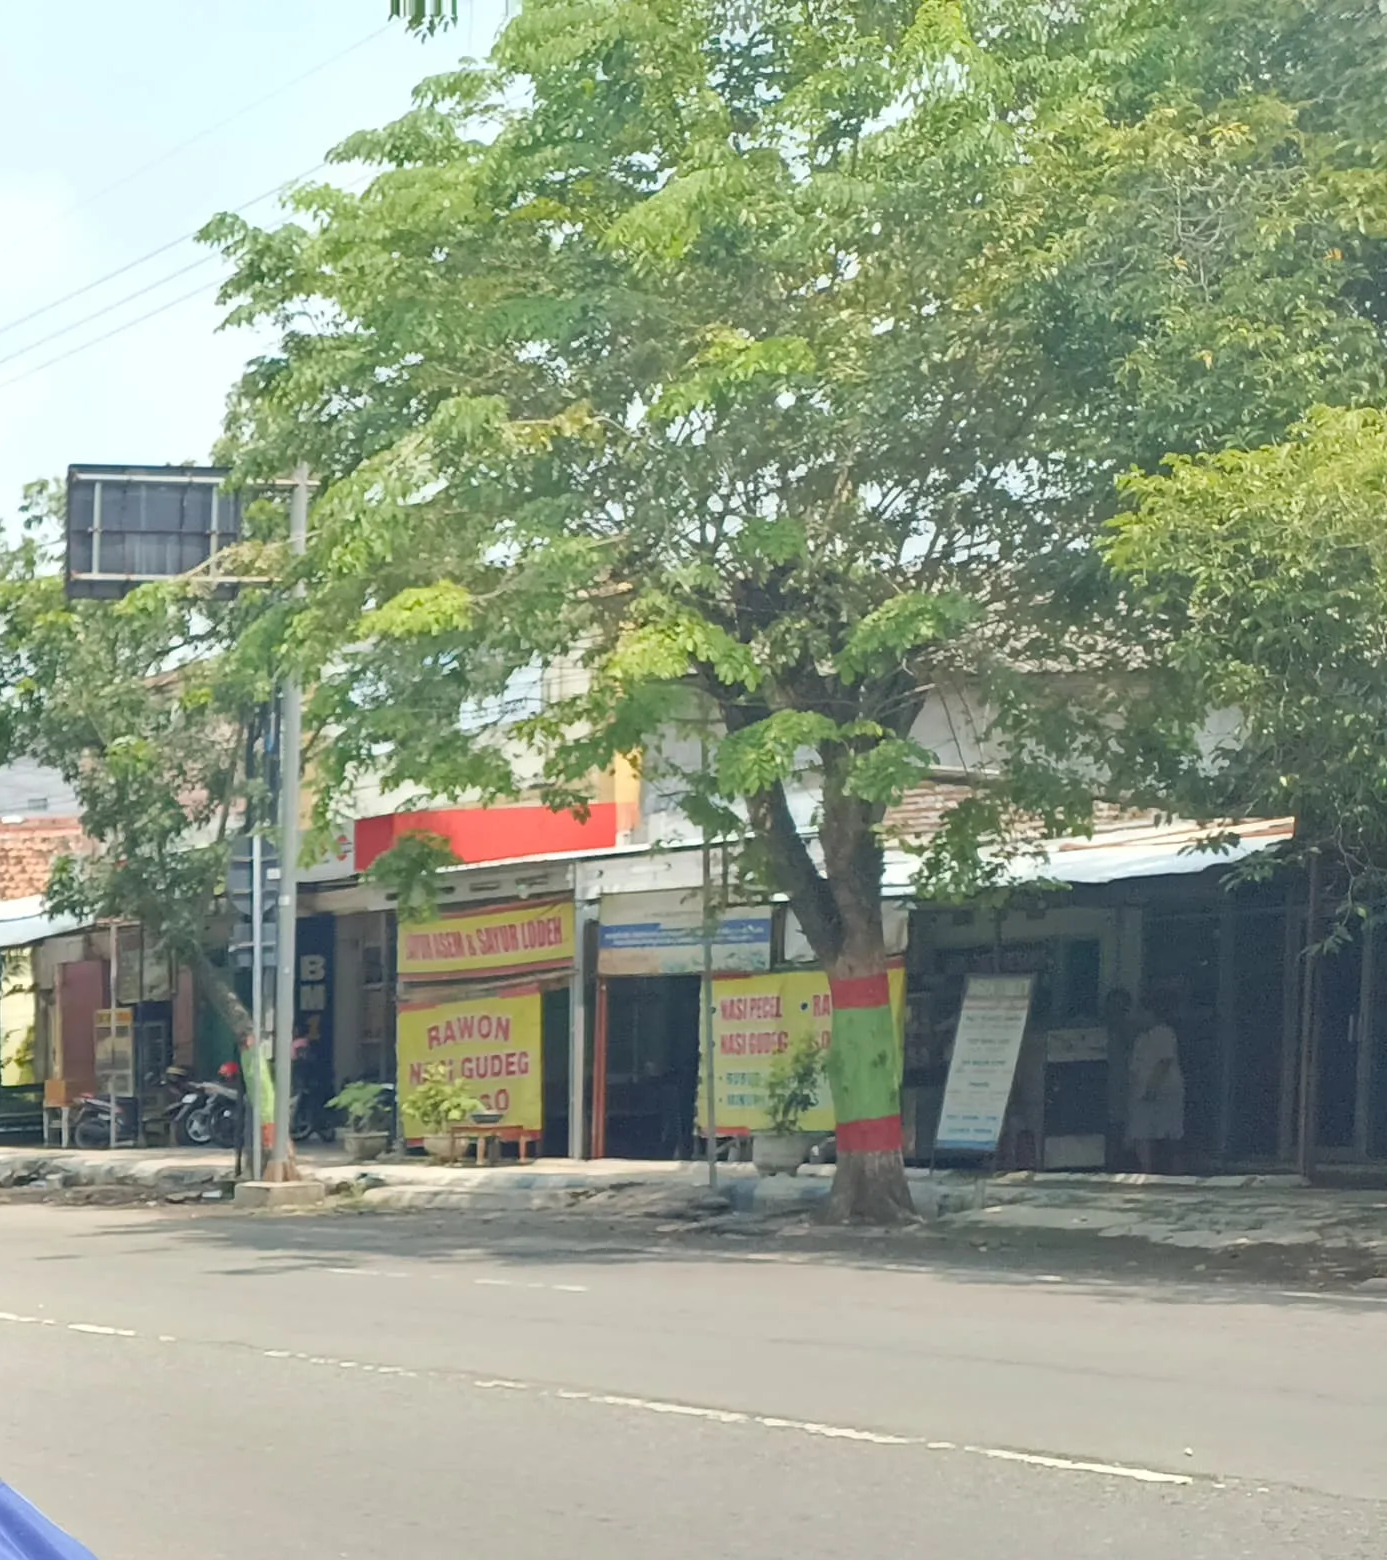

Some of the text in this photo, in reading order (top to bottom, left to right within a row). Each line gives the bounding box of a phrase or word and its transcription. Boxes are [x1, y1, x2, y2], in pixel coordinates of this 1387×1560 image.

[477, 923, 518, 955] SAYUR
[521, 917, 562, 949] LODEH
[427, 1014, 510, 1050] RAWON
[461, 1051, 529, 1079] GUDEG
